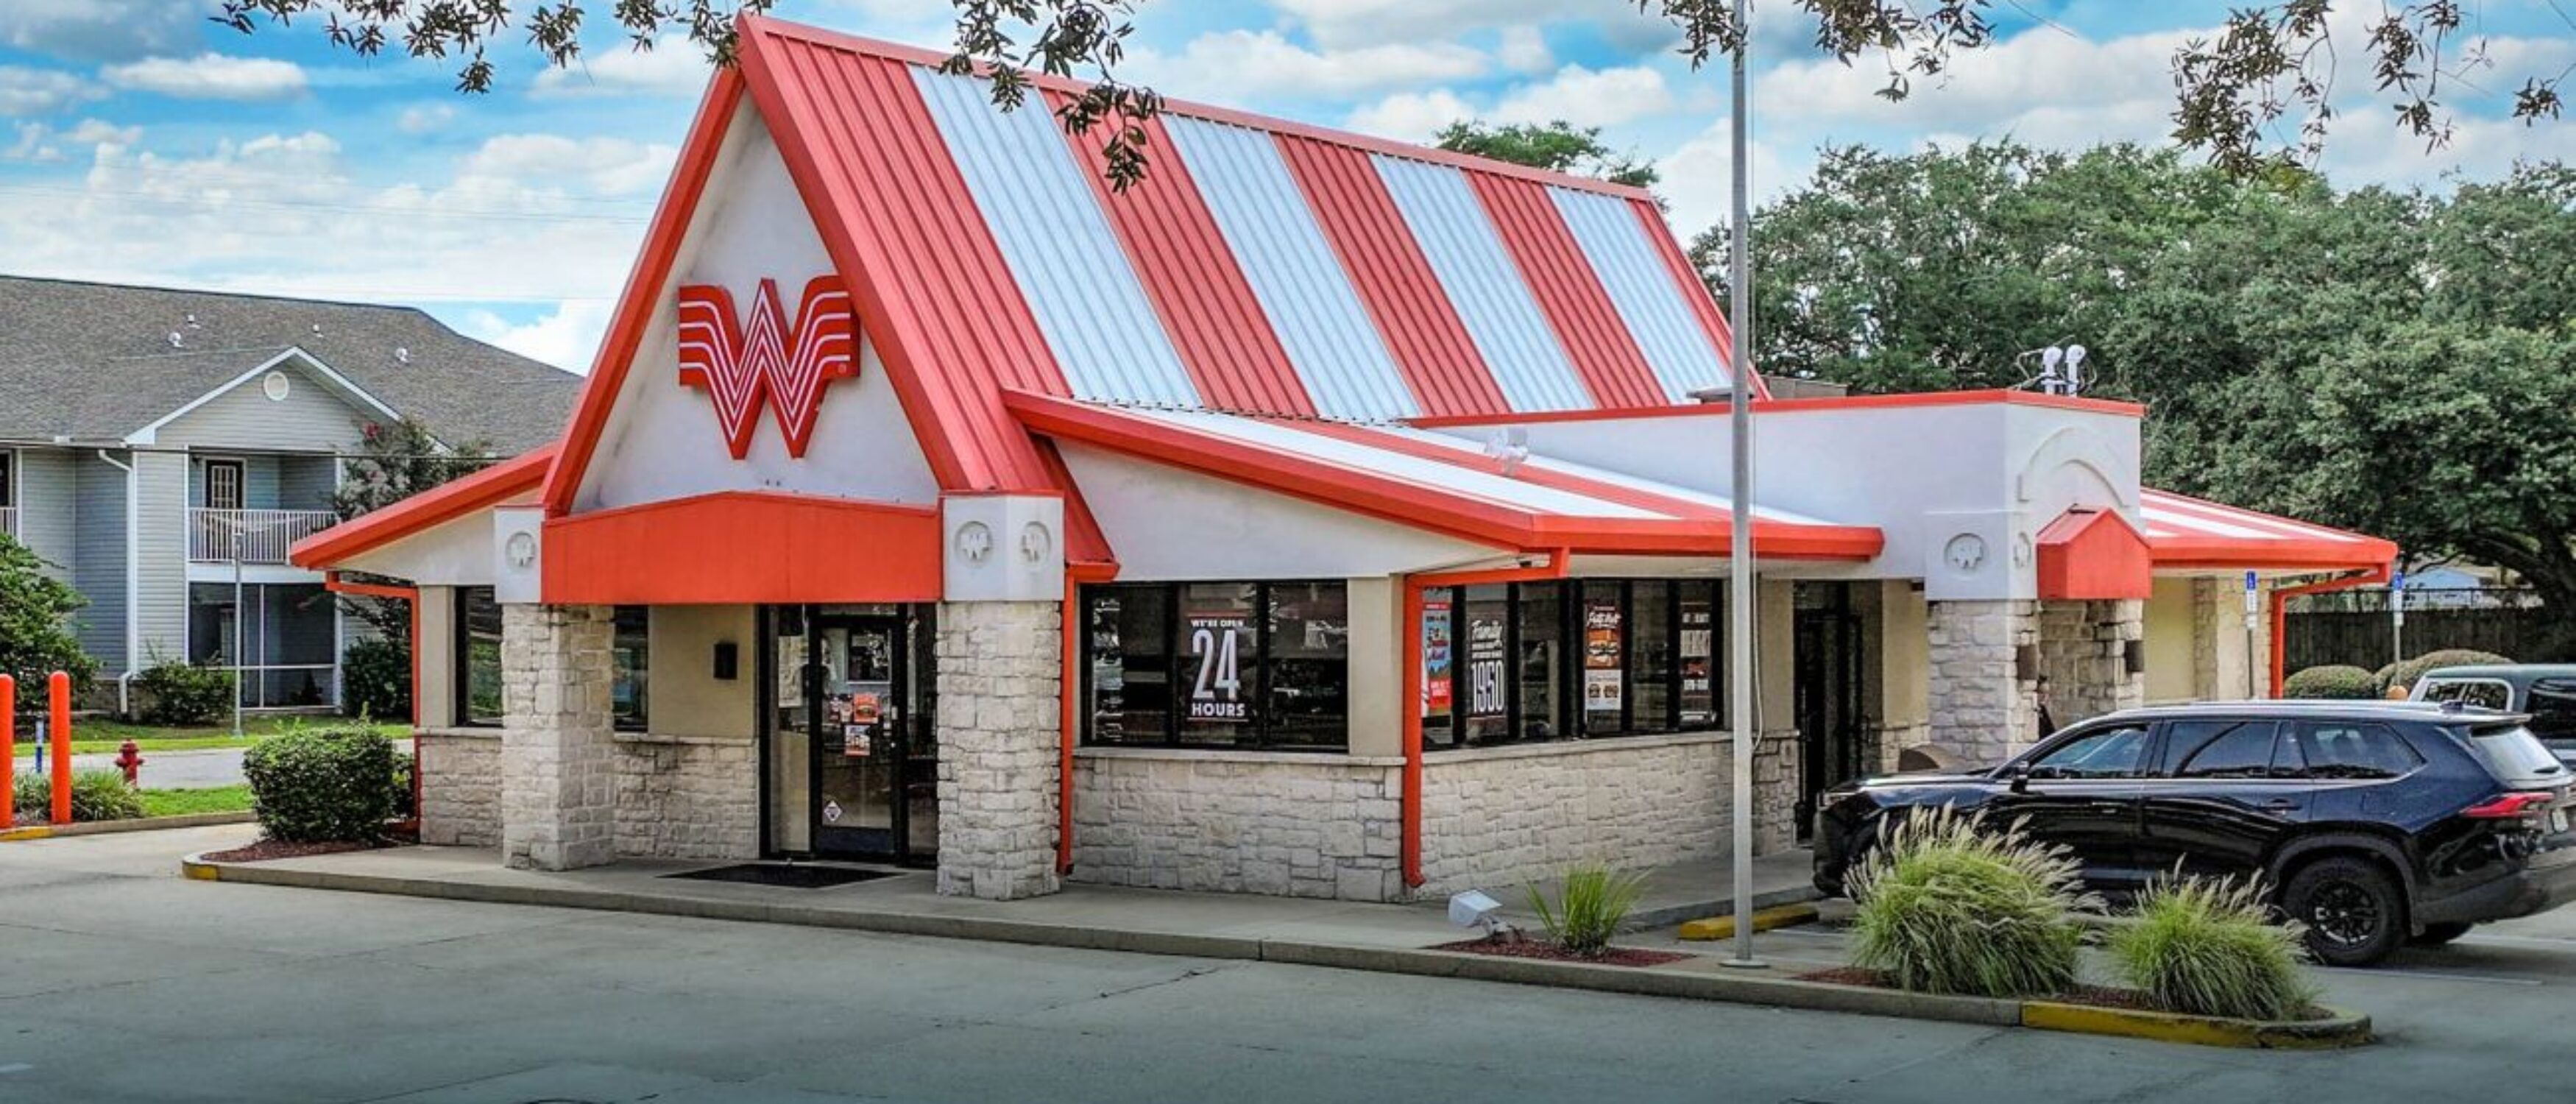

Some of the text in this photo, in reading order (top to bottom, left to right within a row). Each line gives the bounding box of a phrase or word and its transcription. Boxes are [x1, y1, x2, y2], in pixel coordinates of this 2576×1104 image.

[679, 275, 860, 460] W
[1220, 619, 1244, 628] OPEN
[1192, 629, 1241, 701] 24
[1471, 660, 1505, 714] 1950
[1192, 703, 1246, 717] HOURS
